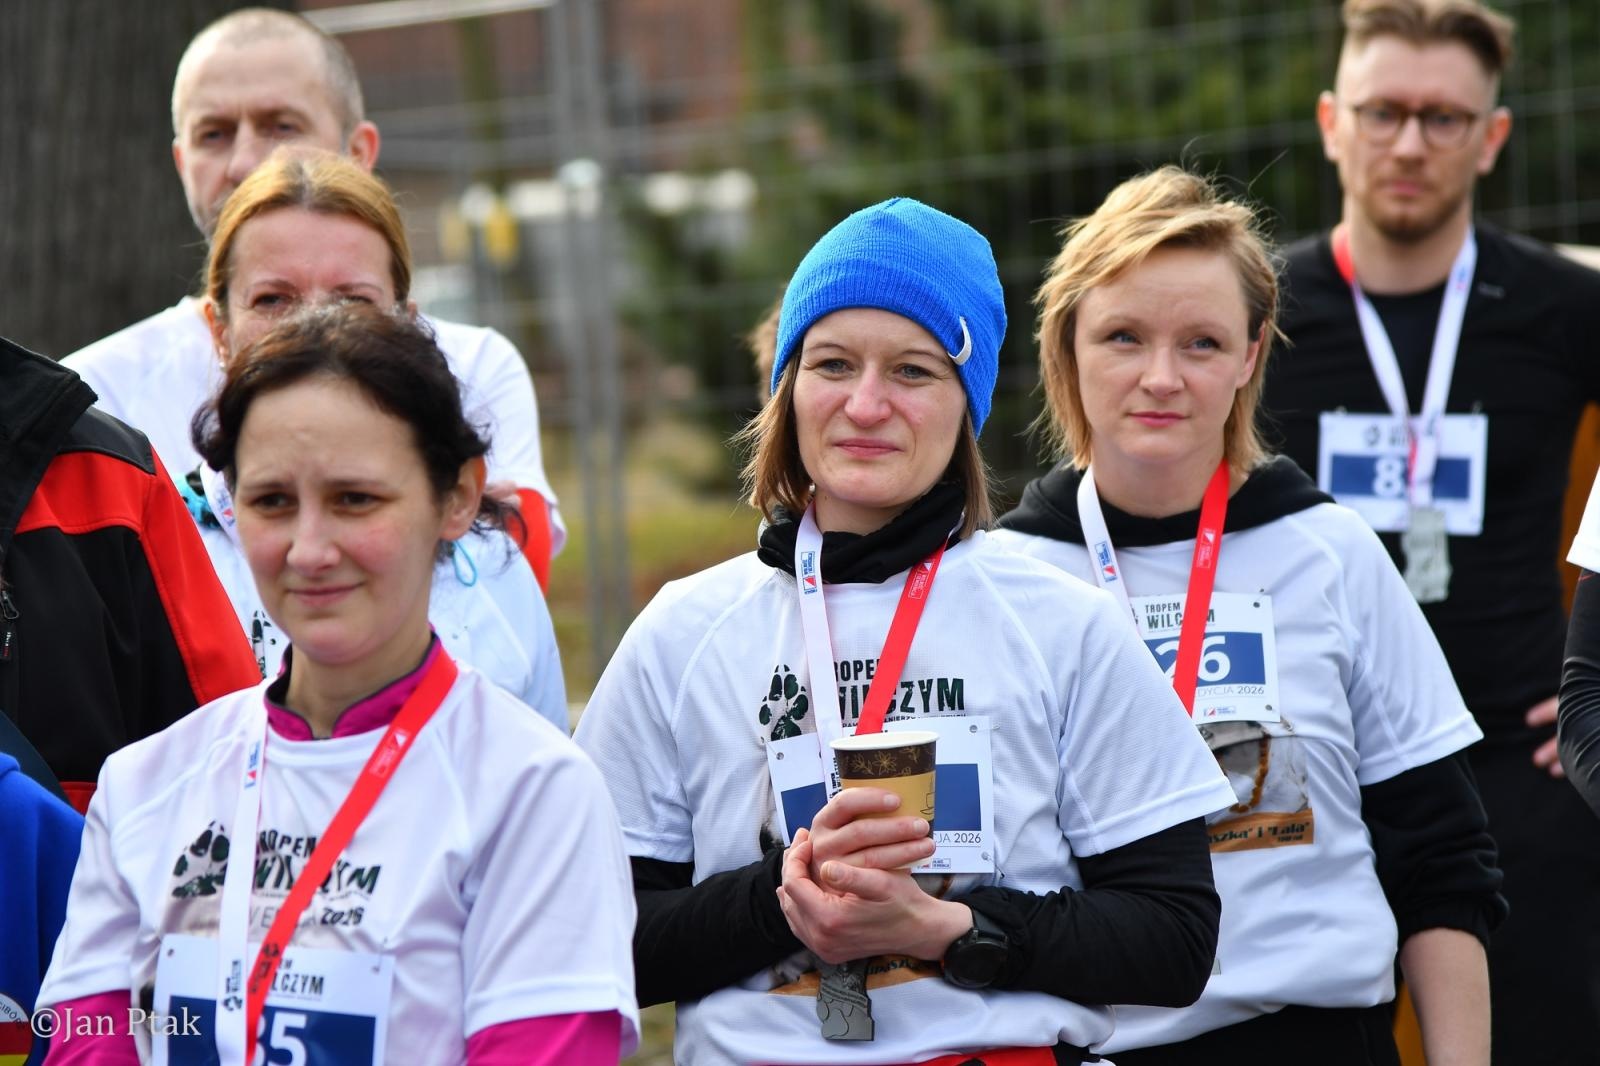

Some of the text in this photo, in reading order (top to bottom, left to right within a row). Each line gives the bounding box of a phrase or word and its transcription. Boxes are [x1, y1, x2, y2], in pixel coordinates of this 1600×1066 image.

[1373, 457, 1405, 497] 8
[1145, 602, 1181, 613] TROPEM
[1147, 609, 1215, 629] WILCM
[1238, 686, 1265, 695] 2026
[954, 833, 981, 843] 2026
[272, 973, 325, 995] LCZYM
